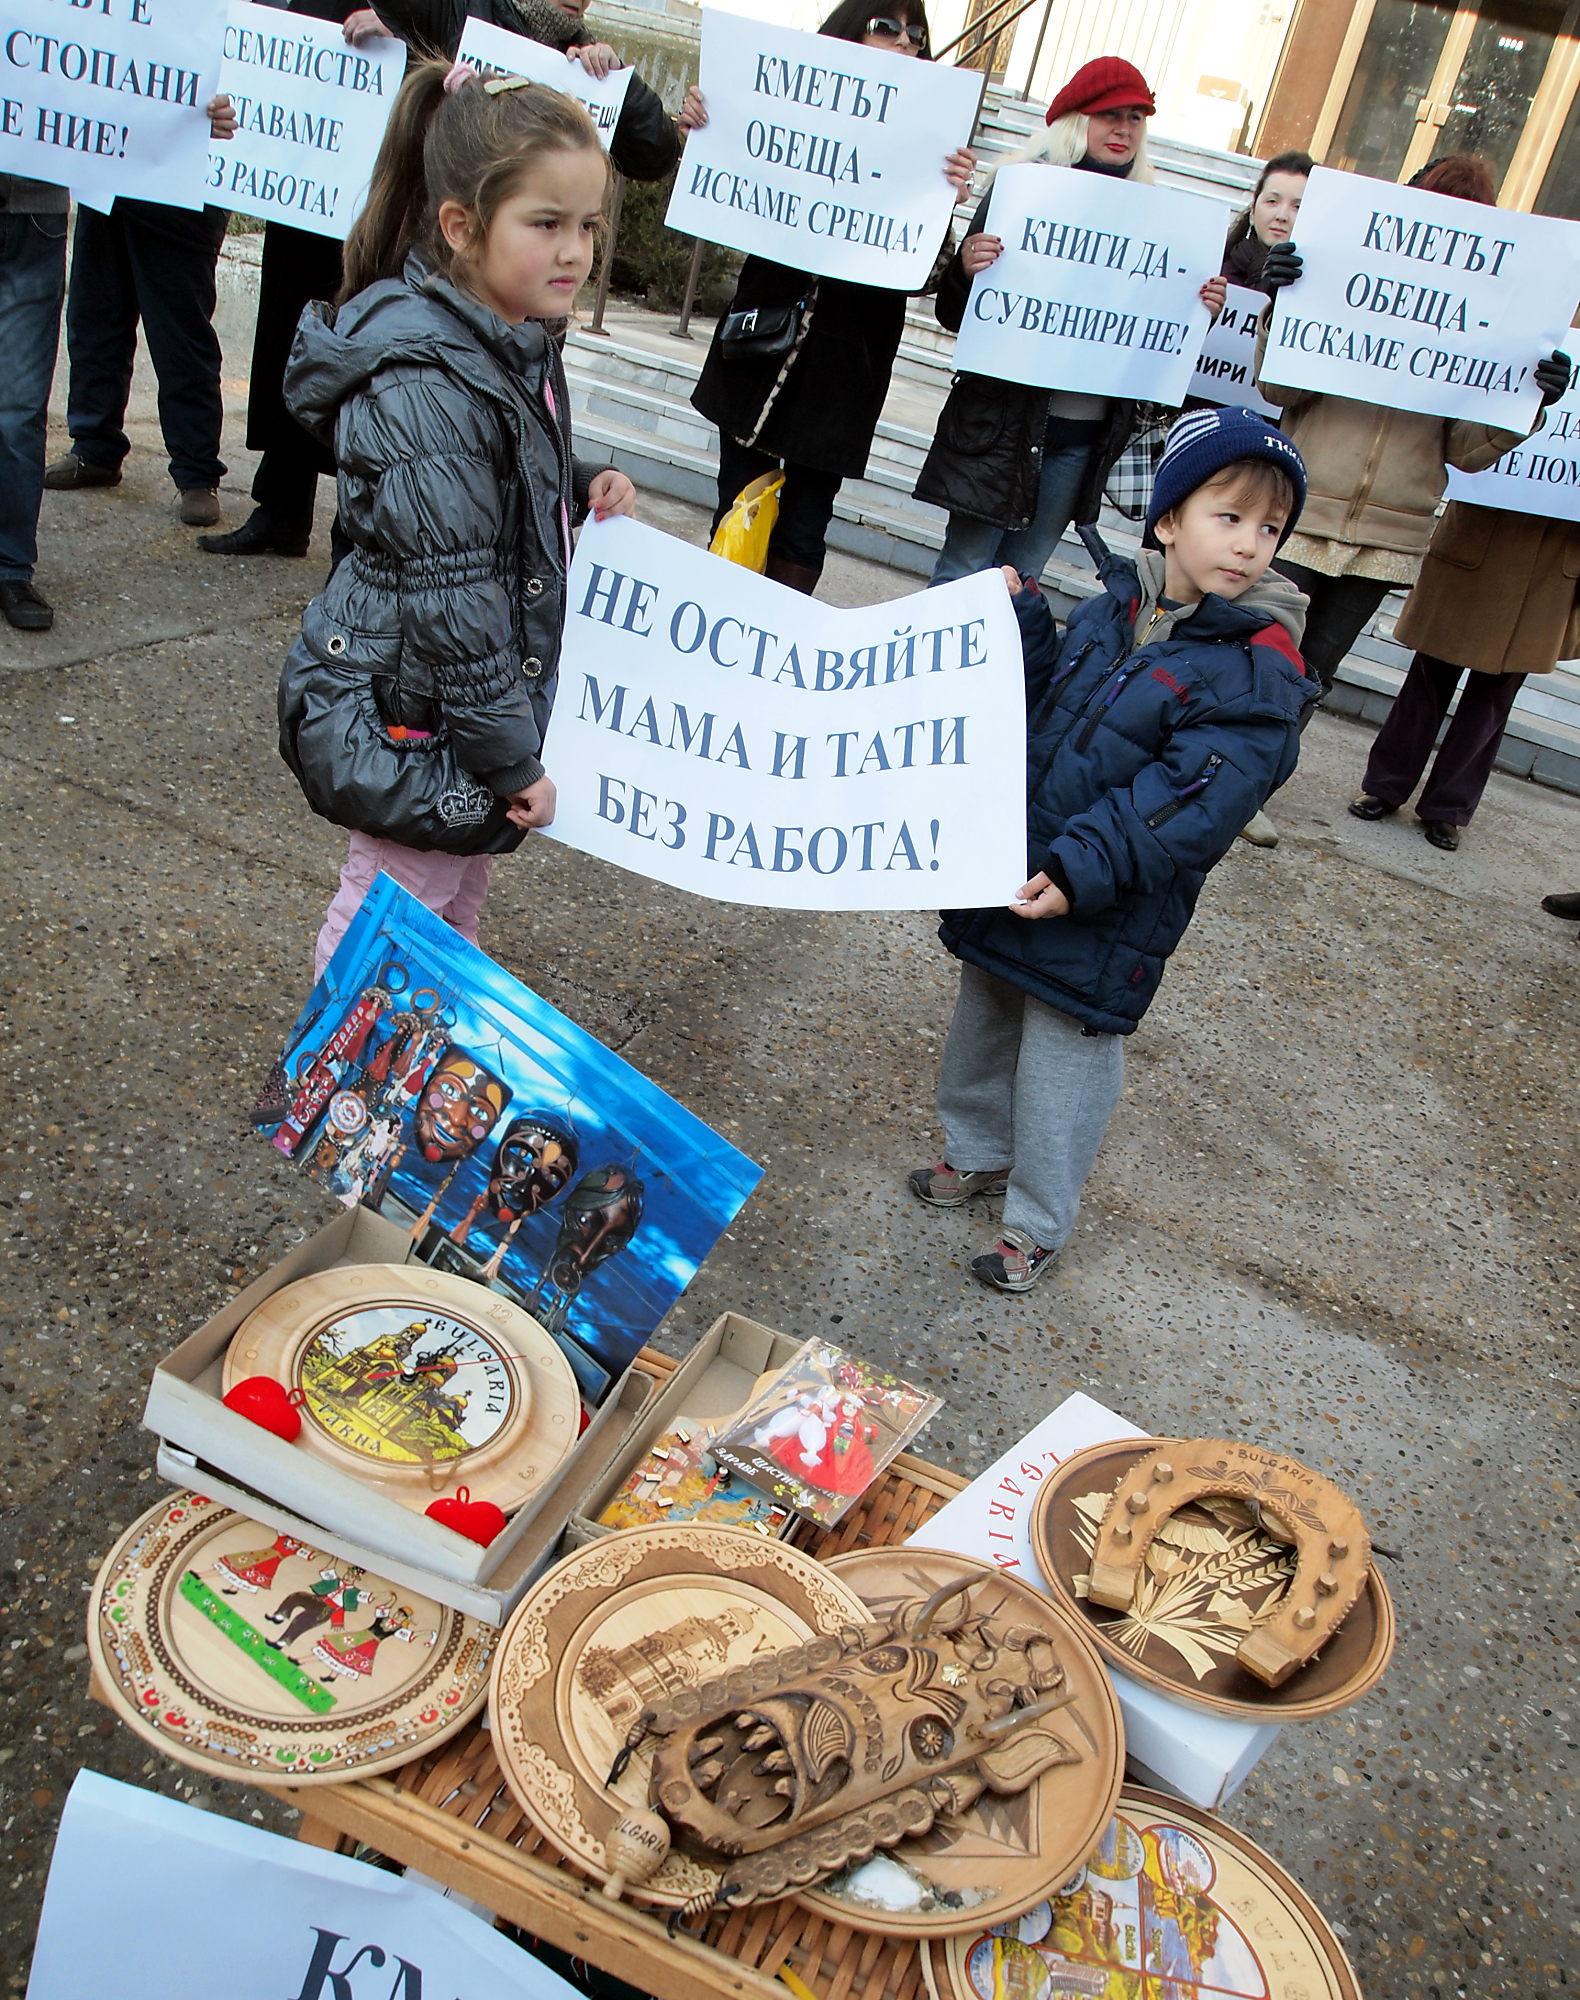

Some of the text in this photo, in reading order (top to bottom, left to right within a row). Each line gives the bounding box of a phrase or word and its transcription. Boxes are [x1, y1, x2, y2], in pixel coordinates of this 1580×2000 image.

[6, 30, 200, 107] СТОПАНИ
[223, 26, 384, 95] СЕМЕЙСТВА
[754, 54, 898, 124] КМЕТЪТ
[36, 106, 130, 158] НИЕ!
[746, 120, 860, 188] ОБЕЩА
[231, 161, 339, 218] РАБОТА!
[688, 164, 924, 256] ИСКАМЕ СРЕЩА!
[1020, 217, 1132, 270] КНИГИ
[1128, 242, 1170, 283] ДА
[1361, 211, 1515, 277] КМЕТЪТ
[974, 288, 1190, 356] СУВЕНИРИ НЕ!
[1346, 273, 1468, 336] ОБЕЩА
[1278, 317, 1405, 370] ИСКАМЕ
[1409, 347, 1528, 395] СРЕЩА!
[576, 562, 988, 692] НЕ ОСТАВЯЙТЕ
[576, 672, 971, 780] МАМА И ТАТИ
[594, 772, 940, 875] БЕЗ РАБОТА!
[1237, 1448, 1313, 1485] BULGARIA
